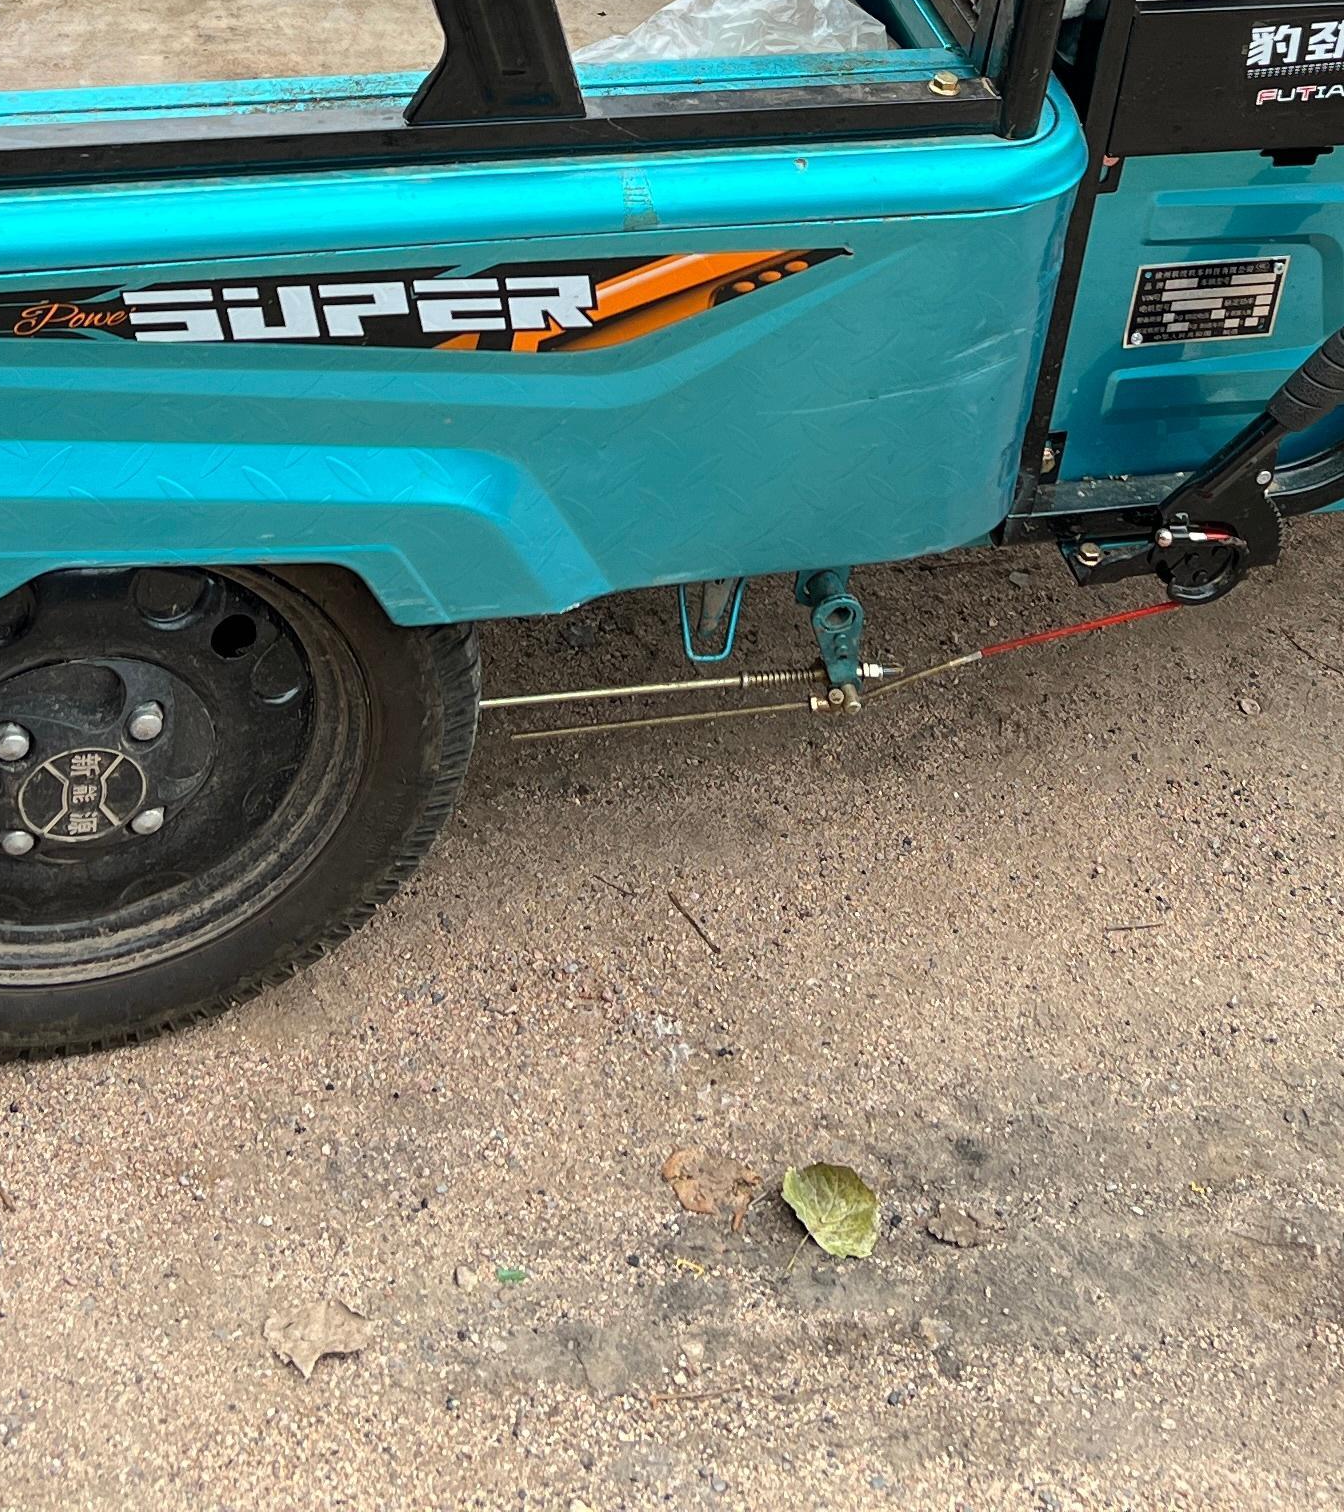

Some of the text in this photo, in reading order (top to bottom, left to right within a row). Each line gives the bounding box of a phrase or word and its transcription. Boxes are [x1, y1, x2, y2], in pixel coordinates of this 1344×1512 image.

[122, 275, 595, 343] SUPER
[67, 752, 102, 836] 新能源
